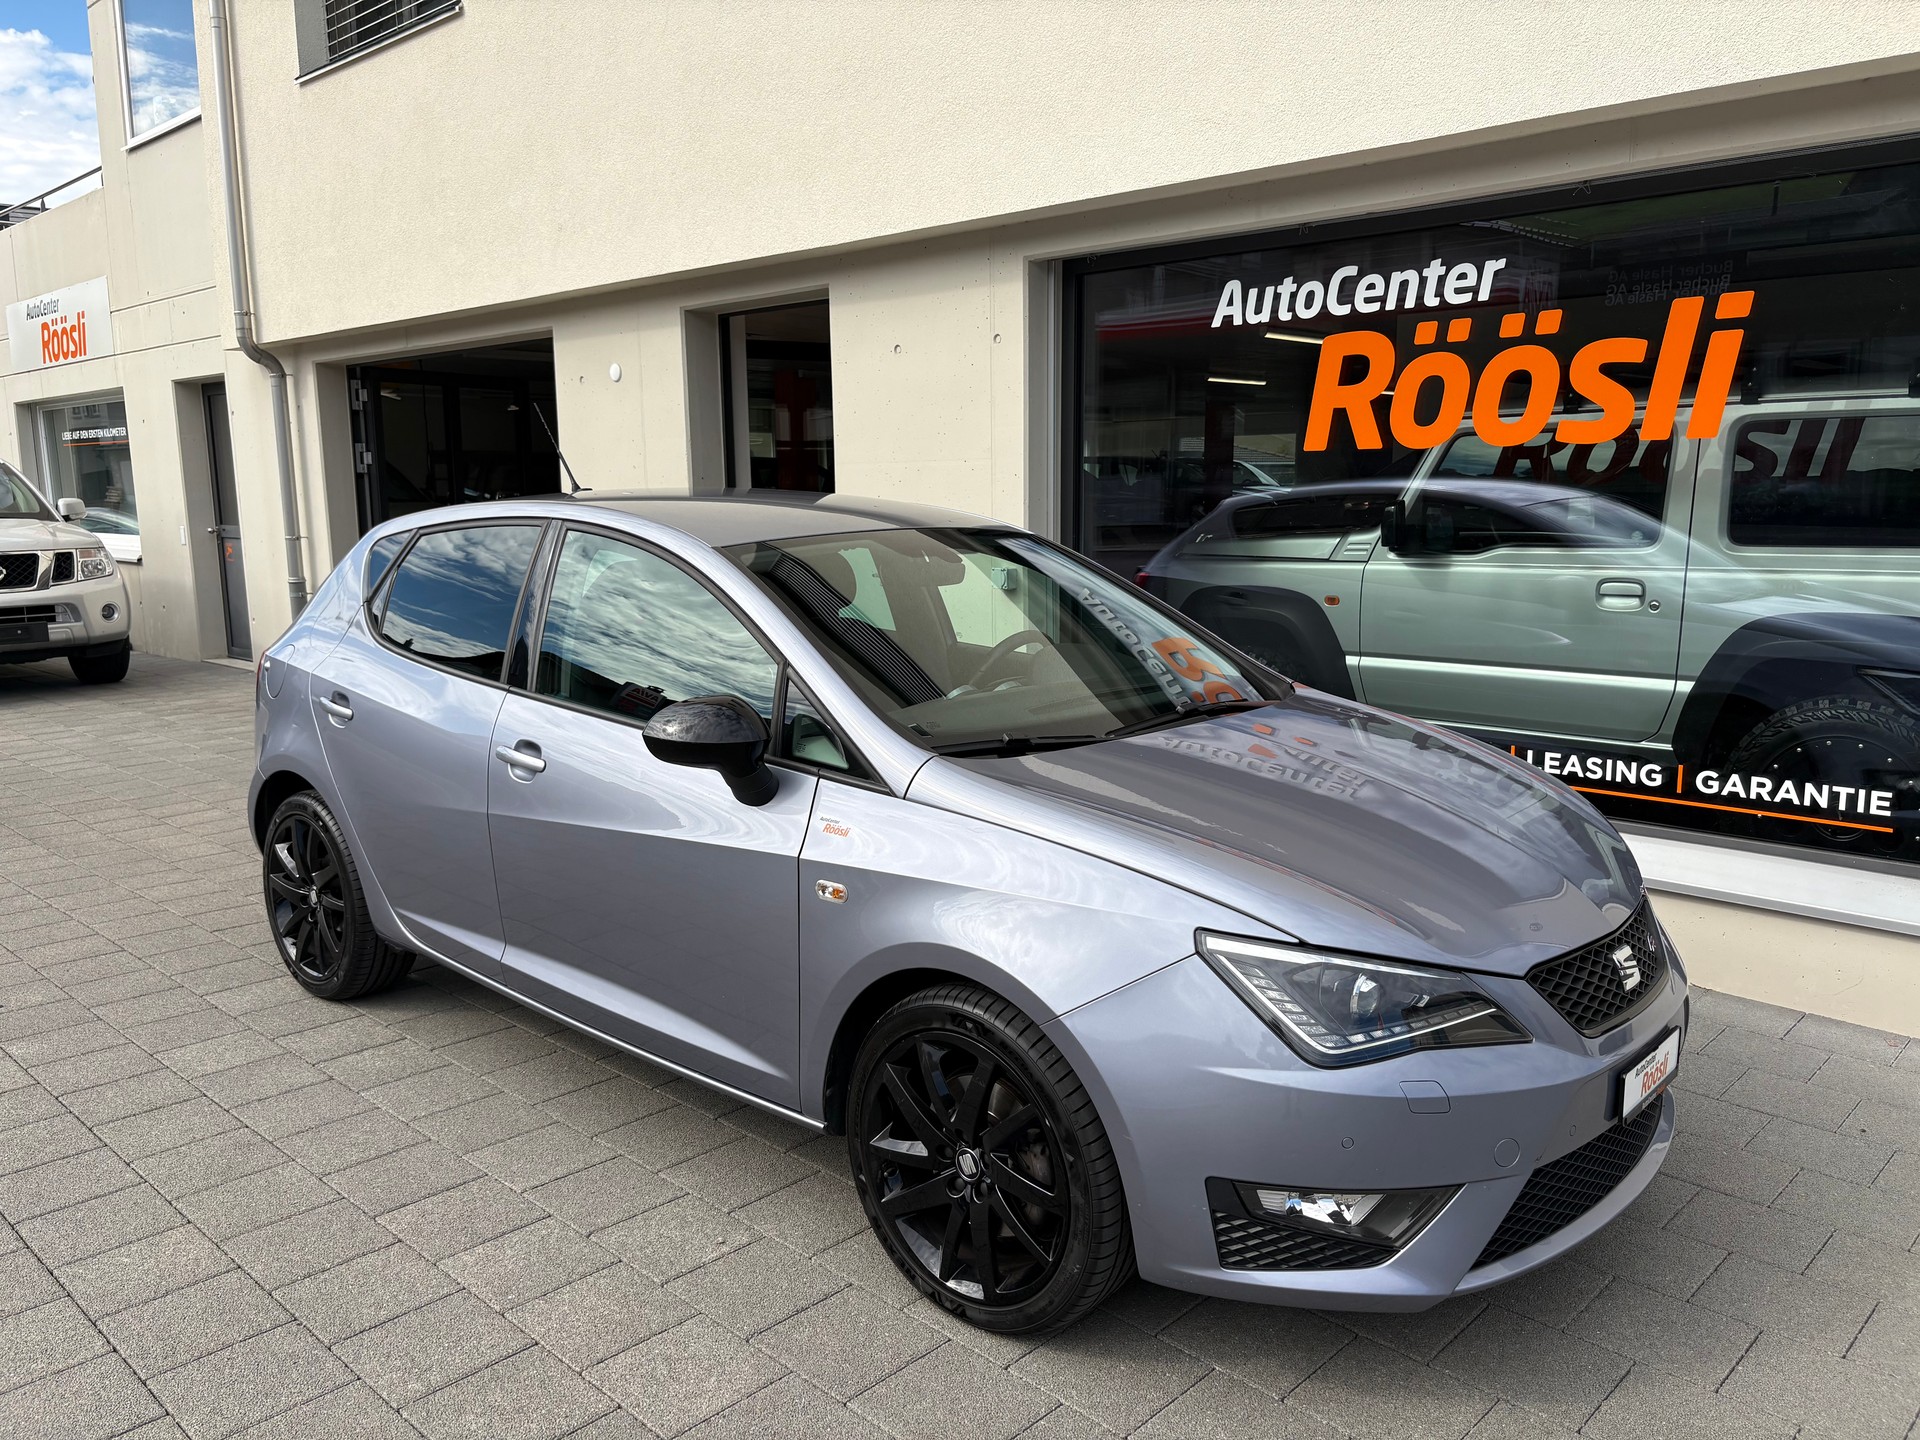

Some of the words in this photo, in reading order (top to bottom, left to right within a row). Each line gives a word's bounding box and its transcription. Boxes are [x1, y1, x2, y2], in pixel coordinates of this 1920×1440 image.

[26, 298, 60, 321] AutoCenter
[1211, 258, 1506, 328] AutoCenter
[41, 310, 87, 364] Röösli
[1303, 290, 1755, 452] Röösli
[1526, 750, 1663, 787] LEASING
[1695, 770, 1893, 817] GARANTIE
[822, 823, 851, 837] Röösli
[1641, 1051, 1669, 1097] Röösli
